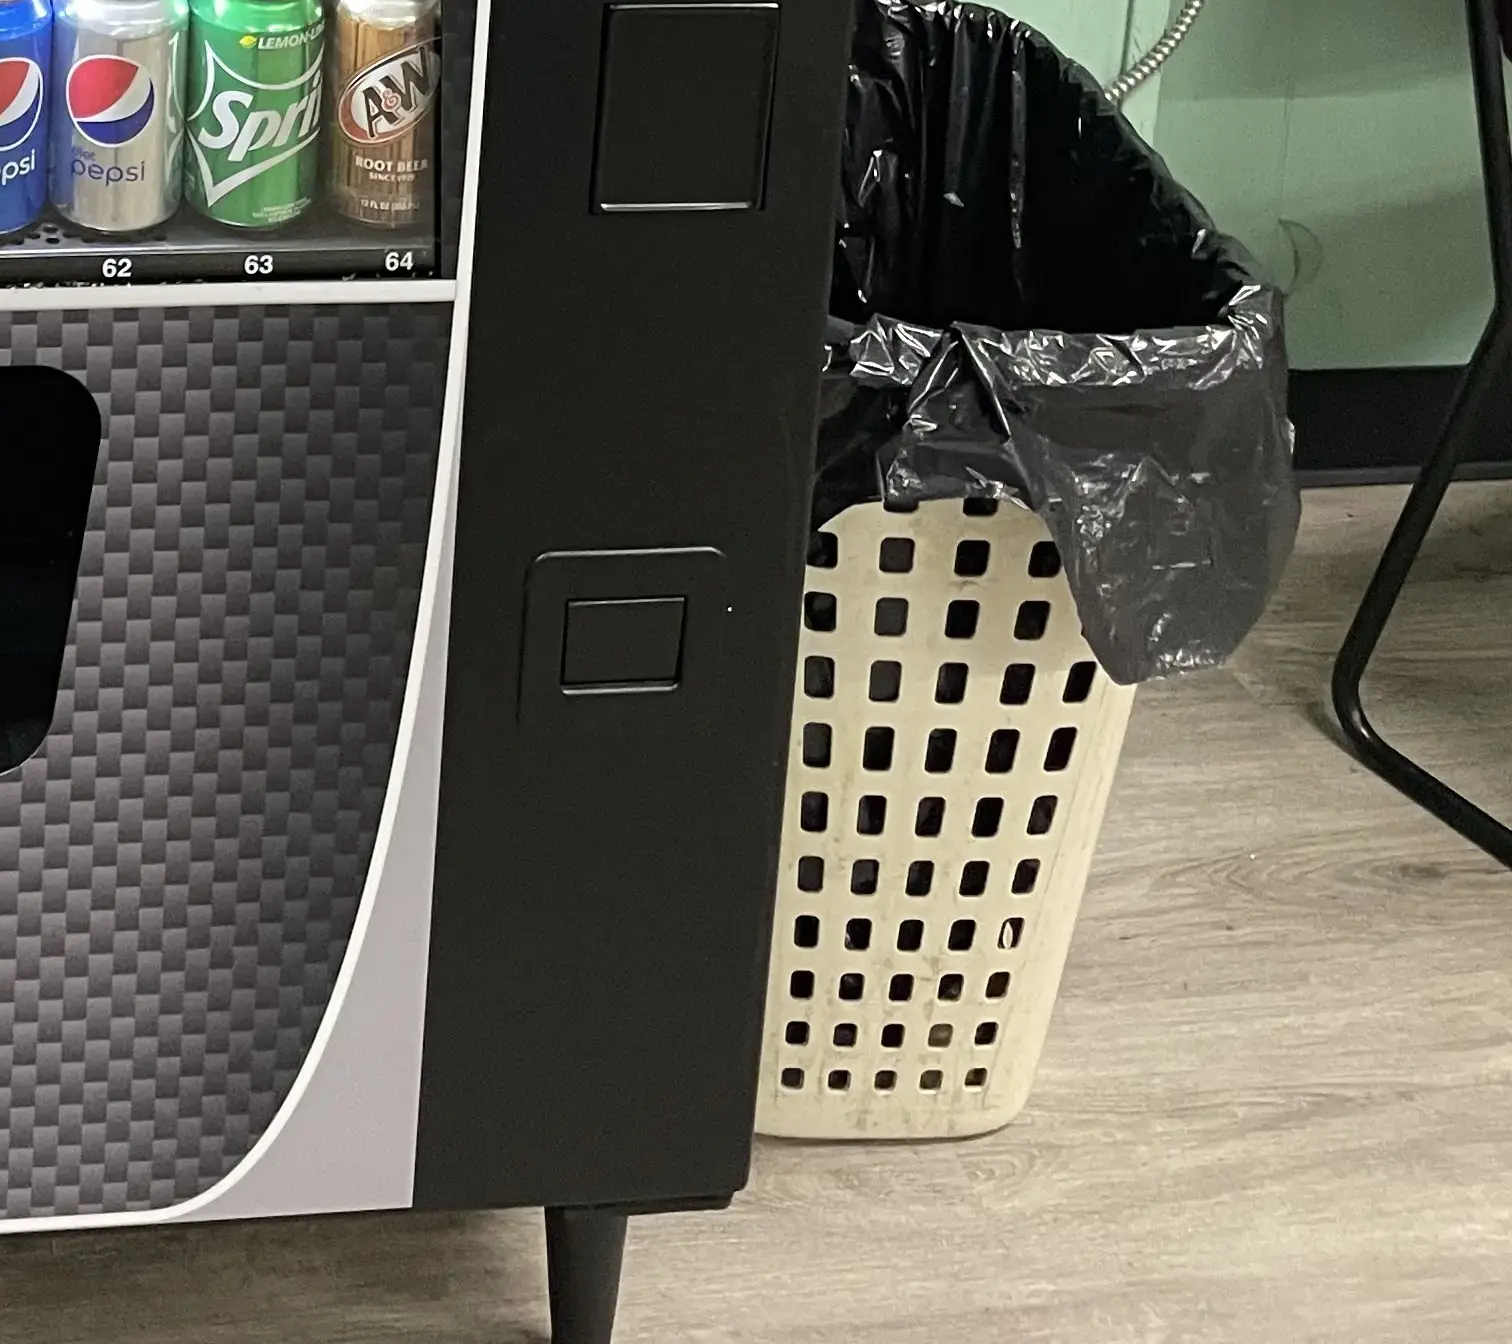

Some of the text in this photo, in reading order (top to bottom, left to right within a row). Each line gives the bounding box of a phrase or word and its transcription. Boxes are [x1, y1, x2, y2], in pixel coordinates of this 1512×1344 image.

[361, 45, 431, 140] A&W
[70, 159, 146, 188] pepsi
[355, 156, 394, 173] ROOT
[101, 257, 132, 280] 62
[243, 253, 275, 275] 63
[384, 251, 415, 273] 64
